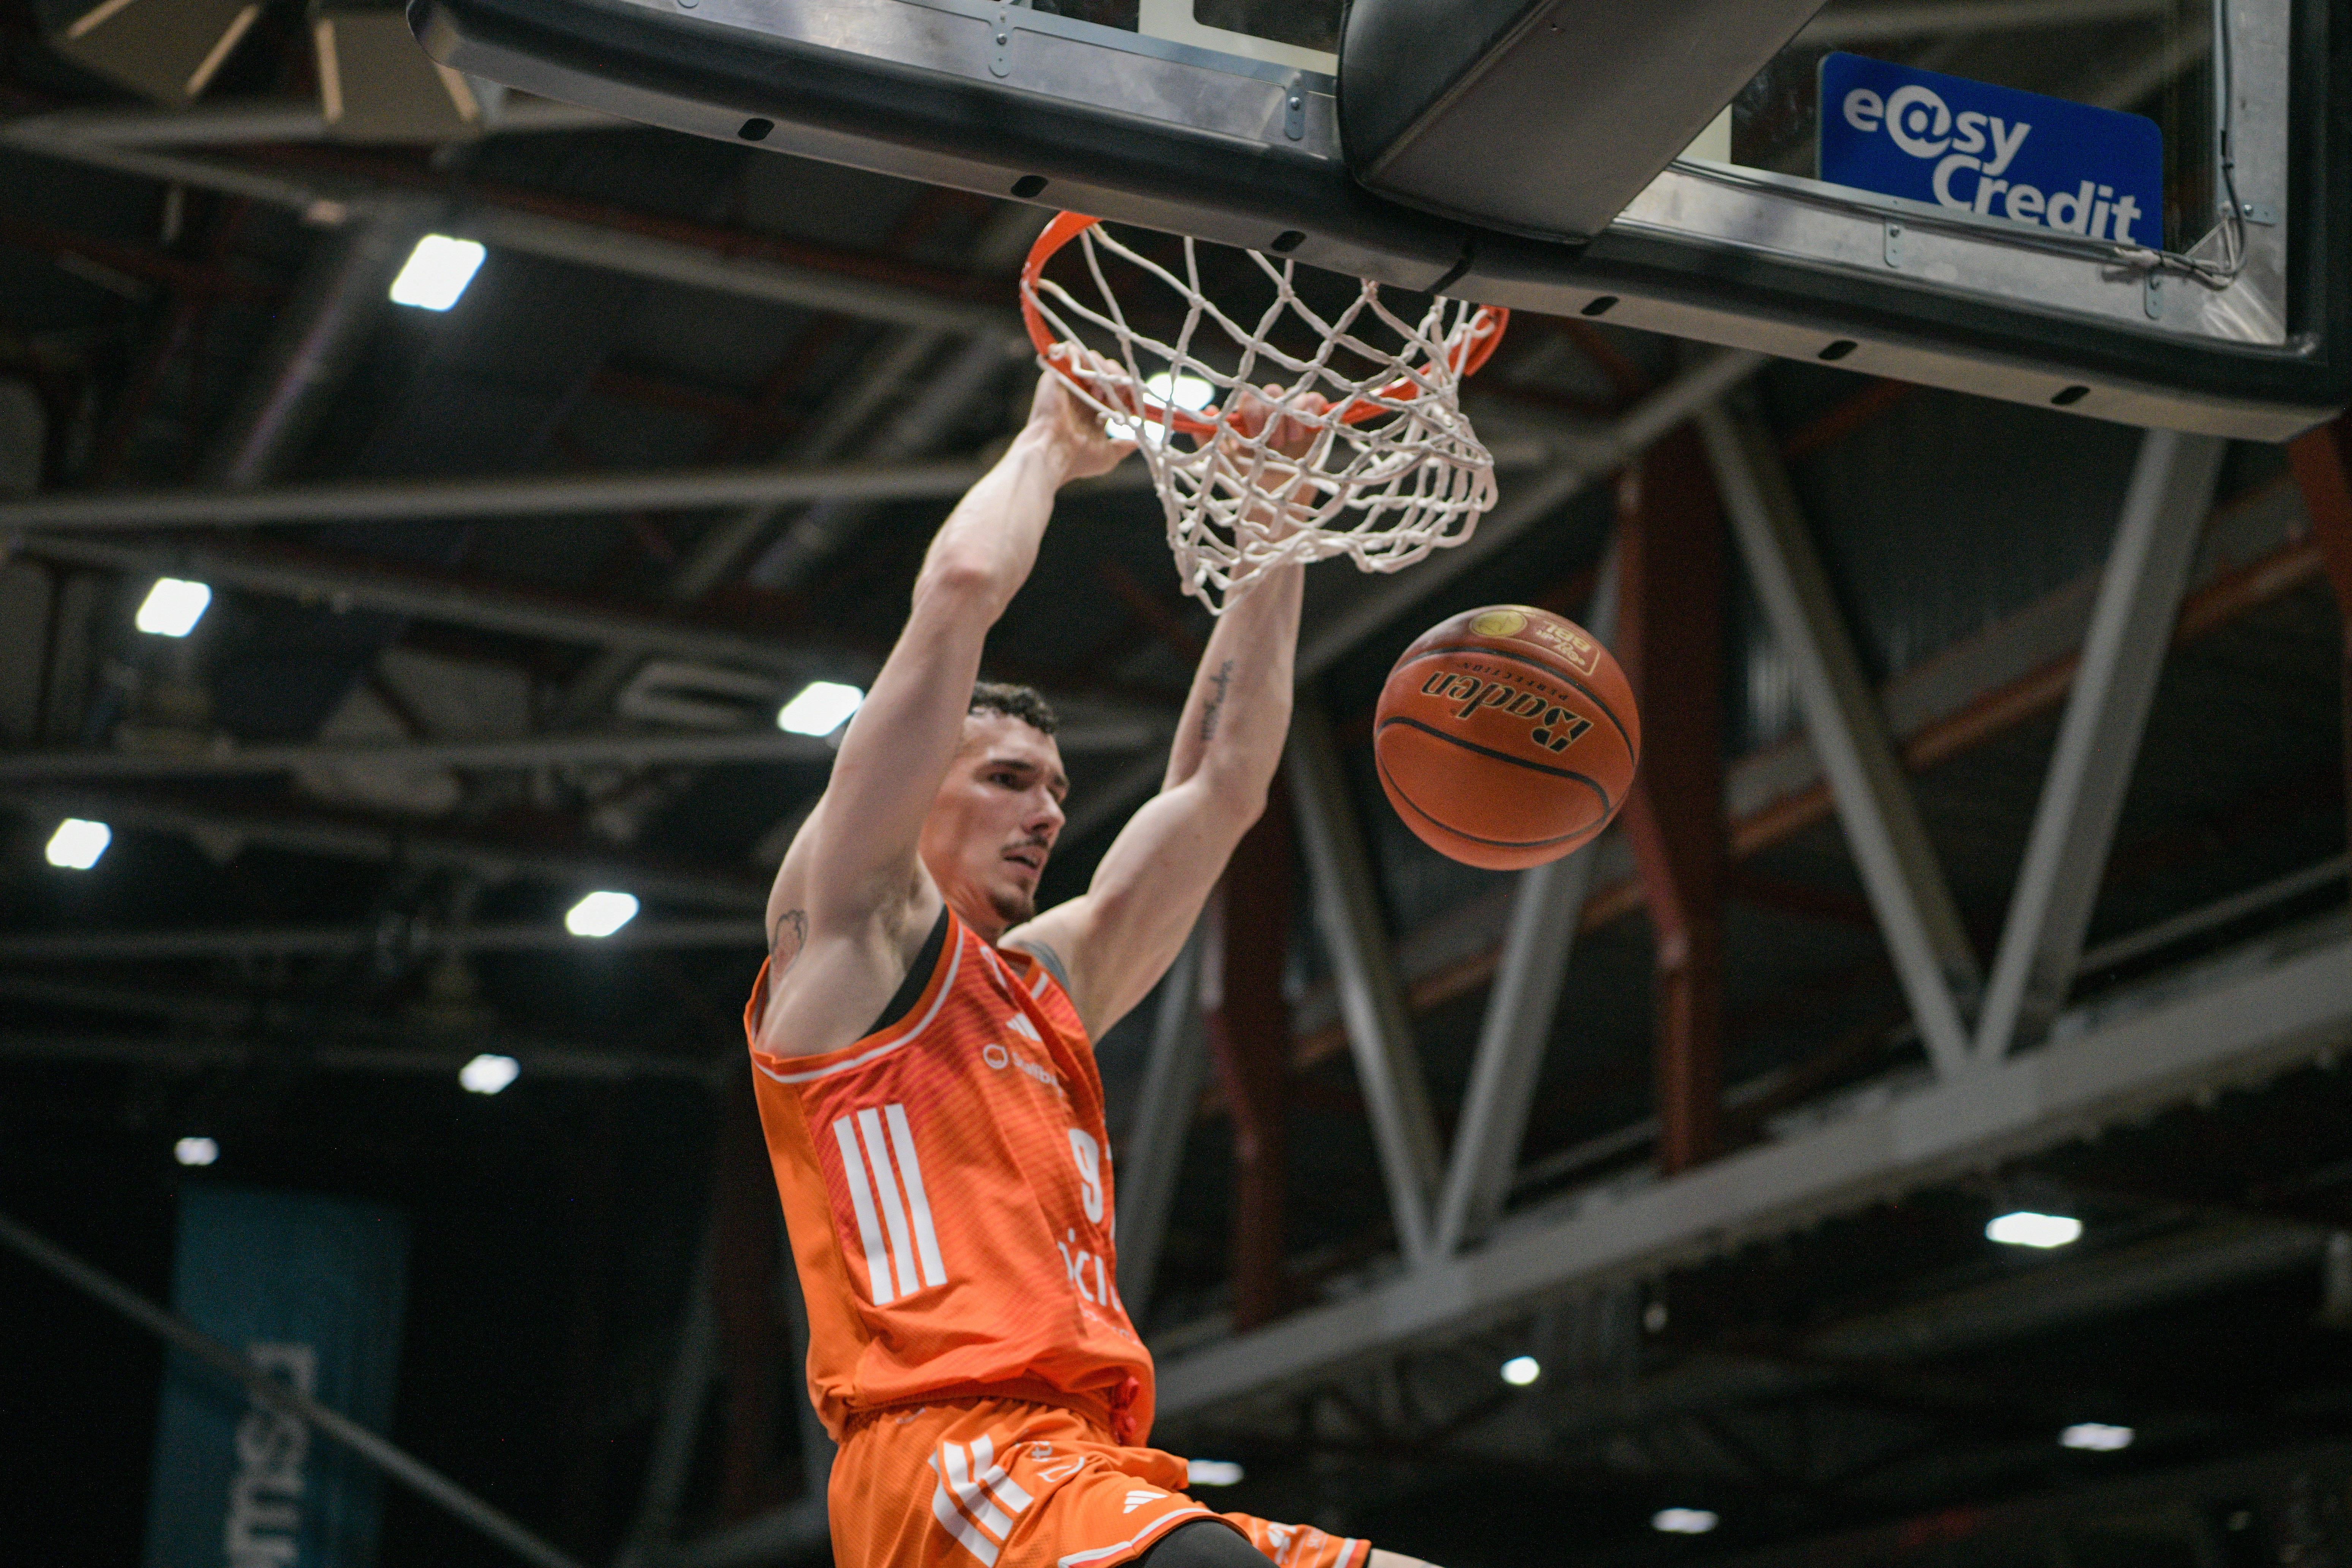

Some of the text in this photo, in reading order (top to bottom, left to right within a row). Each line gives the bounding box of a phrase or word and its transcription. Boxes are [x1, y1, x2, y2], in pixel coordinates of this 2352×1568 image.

[1932, 153, 2142, 245] Credit
[1421, 671, 1594, 754] Baden
[1457, 662, 1569, 701] PERFECTION
